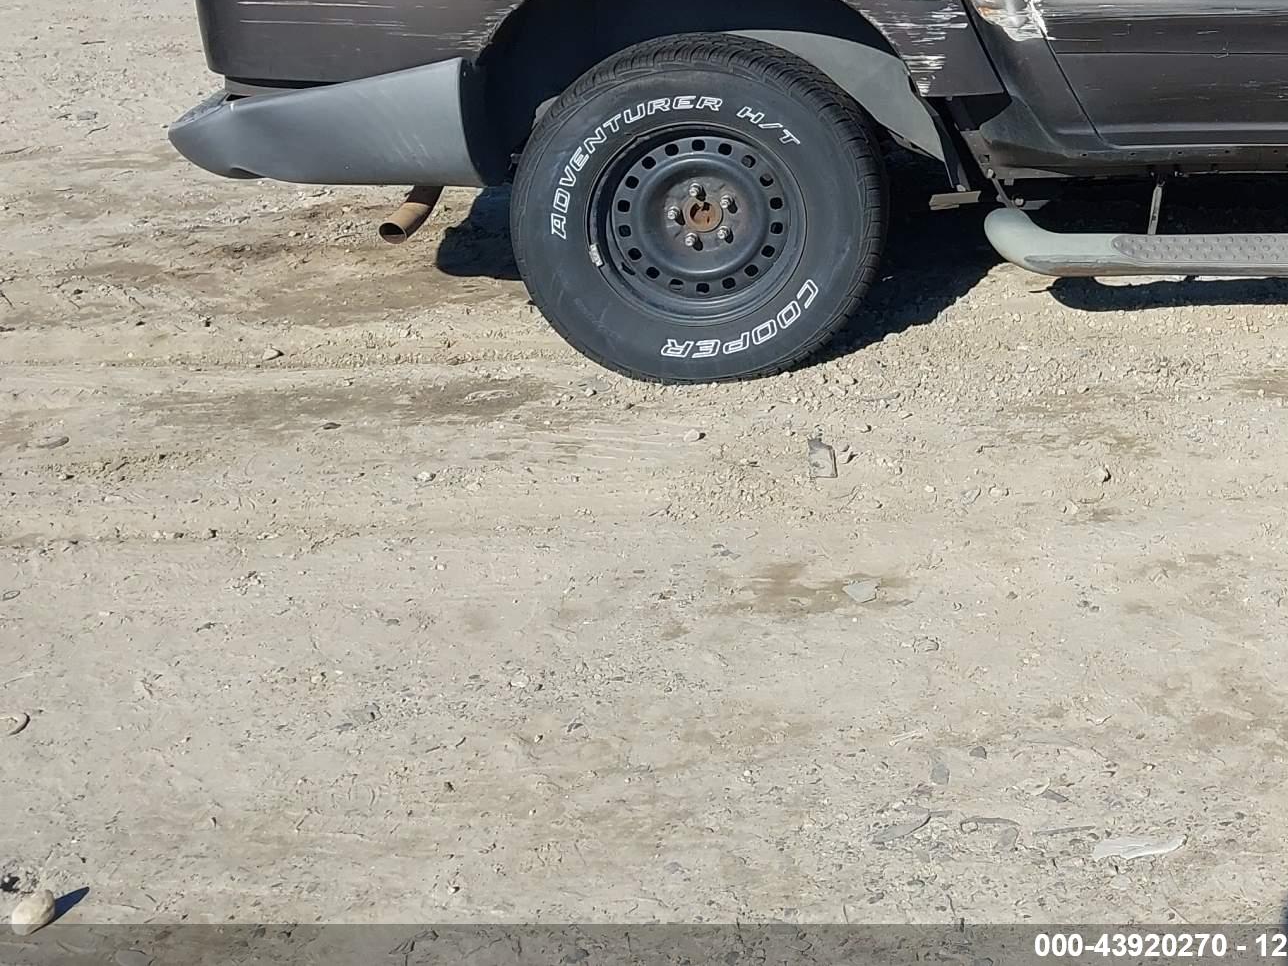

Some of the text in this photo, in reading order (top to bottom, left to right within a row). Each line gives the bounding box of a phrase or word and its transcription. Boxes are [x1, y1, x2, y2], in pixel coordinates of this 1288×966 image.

[551, 95, 801, 240] ADVENTURER H/T
[660, 279, 820, 359] COOPER
